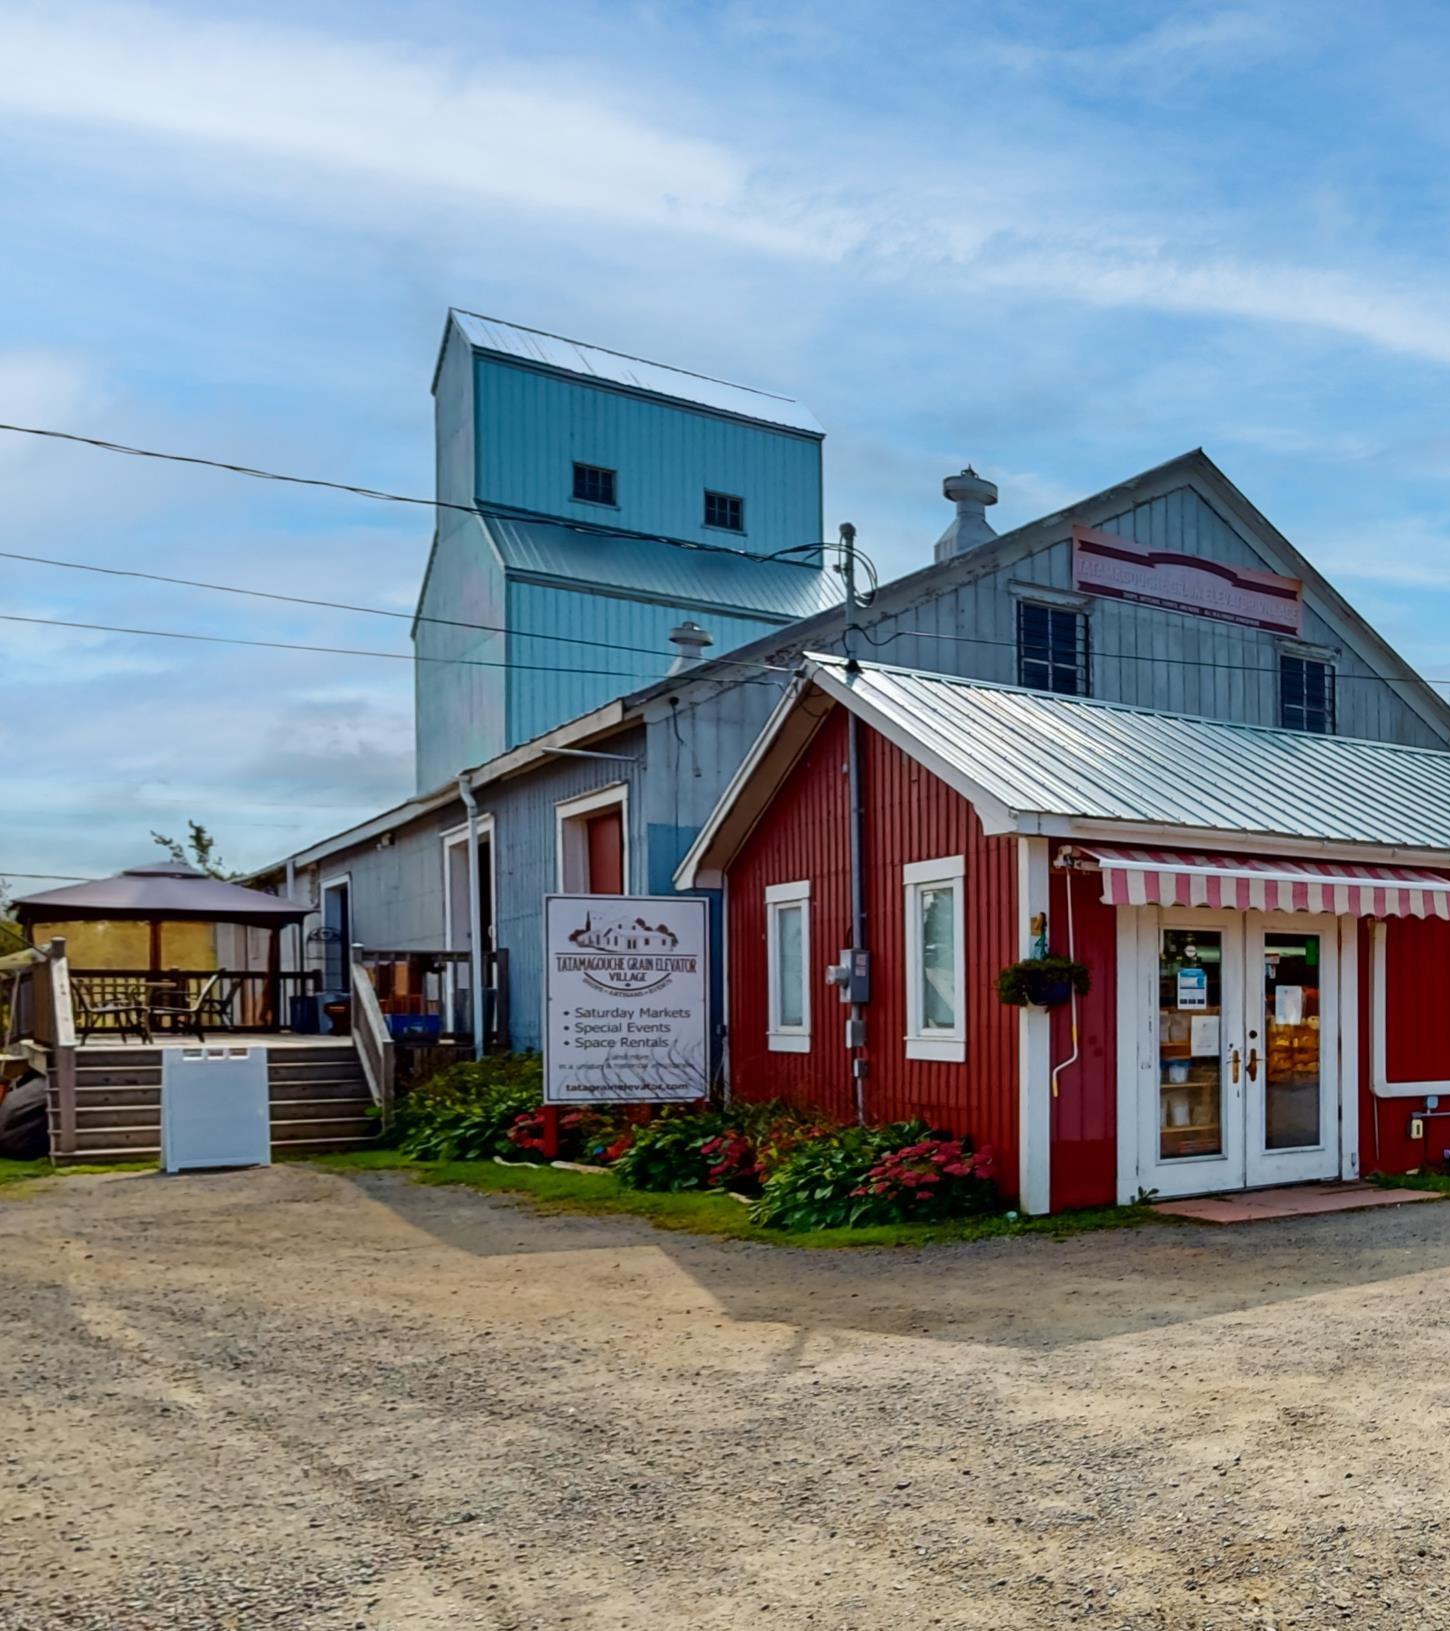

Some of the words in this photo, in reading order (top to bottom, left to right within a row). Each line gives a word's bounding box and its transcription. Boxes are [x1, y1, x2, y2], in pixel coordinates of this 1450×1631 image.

[556, 956, 625, 973] TATAMAGOUCHE
[626, 957, 654, 972] GRAIN
[655, 957, 698, 974] ELEVATOR
[608, 971, 648, 982] VILLAGE
[574, 1007, 635, 1020] Saturday
[639, 1007, 692, 1019] Markets
[574, 1021, 622, 1035] Special
[627, 1022, 672, 1034] Events
[574, 1037, 616, 1050] Space
[620, 1037, 669, 1049] Rentals
